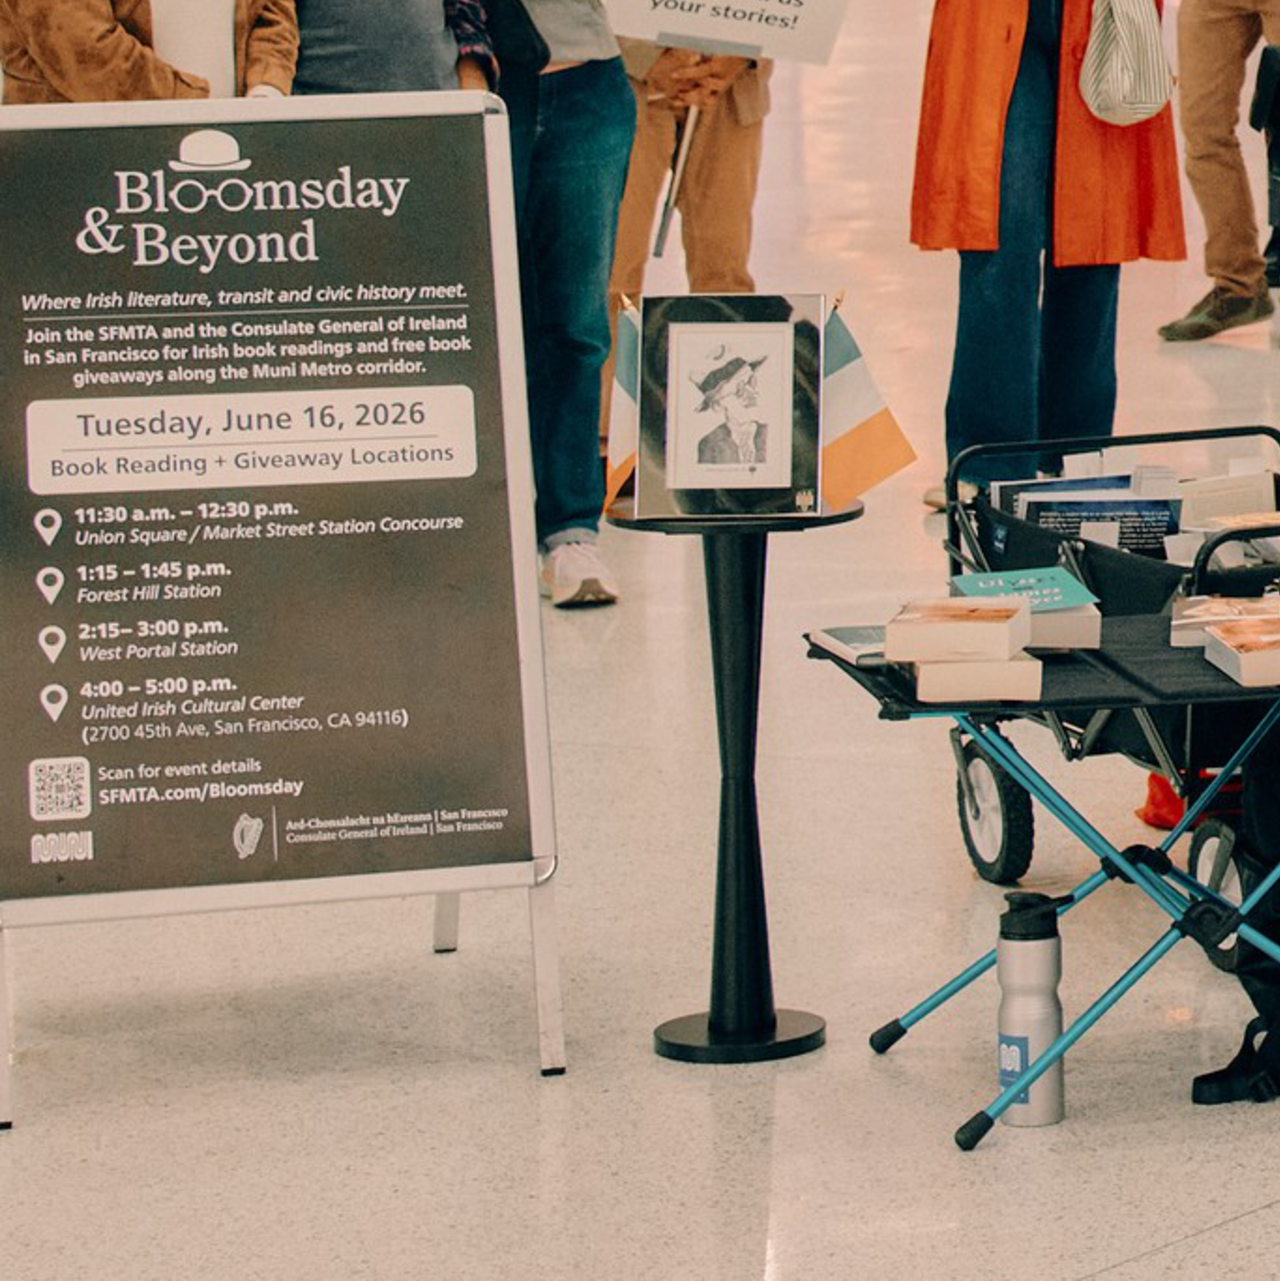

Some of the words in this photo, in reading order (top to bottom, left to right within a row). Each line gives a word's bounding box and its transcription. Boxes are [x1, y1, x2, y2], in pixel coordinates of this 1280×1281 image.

[711, 3, 800, 31] stories!
[114, 166, 410, 217] Bloomsday
[75, 206, 126, 255] &
[131, 218, 320, 275] Beyond
[21, 294, 82, 311] Where
[85, 291, 123, 309] Irish
[127, 290, 212, 308] literature,
[218, 287, 275, 306] transit
[277, 286, 313, 304] and
[316, 285, 354, 302] civic
[356, 284, 416, 303] history
[419, 282, 468, 299] meet.
[26, 327, 61, 344] Join
[65, 327, 95, 342] the
[98, 324, 159, 341] SFMTA
[161, 323, 195, 339] and
[198, 322, 228, 338] the
[231, 319, 316, 338] Consulate
[318, 316, 384, 334] General
[387, 316, 406, 332] of
[409, 314, 468, 331] Ireland
[23, 349, 41, 366] in
[44, 349, 78, 365] San
[81, 346, 160, 363] Francisco
[162, 344, 189, 361] for
[192, 343, 229, 360] Irish
[233, 341, 277, 359] book
[280, 339, 354, 358] readings
[356, 337, 389, 354] and
[391, 336, 427, 353] free
[429, 334, 473, 352] book
[72, 369, 164, 389] giveaways
[167, 365, 217, 384] along
[220, 363, 249, 379] the
[252, 362, 298, 379] Muni
[300, 360, 353, 378] Metro
[356, 358, 427, 375] corridor.
[76, 410, 213, 440] Tuesday,
[222, 407, 294, 432] June
[303, 405, 345, 432] 16,
[354, 401, 426, 427] 2026
[51, 456, 107, 477] Book
[115, 452, 208, 476] Reading
[214, 455, 227, 469] +
[233, 449, 344, 471] Giveaway
[350, 444, 454, 465] Locations
[74, 506, 128, 524] 11:30
[131, 505, 176, 522] a.m.
[197, 501, 251, 520] 12:30
[253, 501, 300, 520] p.m.
[74, 529, 126, 546] Union
[129, 526, 189, 547] Square
[188, 525, 201, 545] /
[203, 523, 262, 541] Market
[266, 520, 316, 538] Street
[318, 518, 376, 535] Station
[379, 515, 464, 532] Concourse
[76, 564, 118, 582] 1:15
[140, 561, 182, 579] 1:45
[186, 562, 232, 580] p.m.
[77, 587, 129, 604] Forest
[132, 584, 159, 601] Hill
[163, 582, 222, 600] Station
[137, 619, 180, 638] 3:00
[184, 620, 229, 639] p.m.
[79, 645, 122, 662] West
[126, 641, 177, 660] Portal
[180, 639, 239, 658] Station
[80, 680, 124, 698] 4:00
[145, 677, 188, 695] 5:00
[192, 677, 238, 697] p.m.
[81, 702, 138, 720] United
[142, 700, 177, 717] Irish
[181, 695, 246, 715] Cultural
[249, 694, 305, 711] Center
[81, 725, 131, 747] (2700
[133, 723, 172, 739] 45th
[175, 721, 210, 738] Ave,
[214, 719, 244, 736] San
[248, 715, 324, 733] Francisco,
[327, 712, 353, 729] CA
[355, 707, 409, 728] 94116)
[98, 765, 135, 782] Scan
[138, 763, 162, 779] for
[164, 762, 208, 778] event
[211, 757, 262, 775] details
[98, 777, 305, 805] SFMTA.com/Bloomsday
[372, 816, 385, 825] na
[440, 808, 460, 820] San
[460, 807, 509, 819] Francisco
[285, 830, 337, 844] Consulate
[338, 826, 378, 840] General
[379, 825, 392, 837] of
[392, 823, 428, 836] Ireland
[436, 822, 455, 834] San
[456, 819, 504, 832] Francisco
